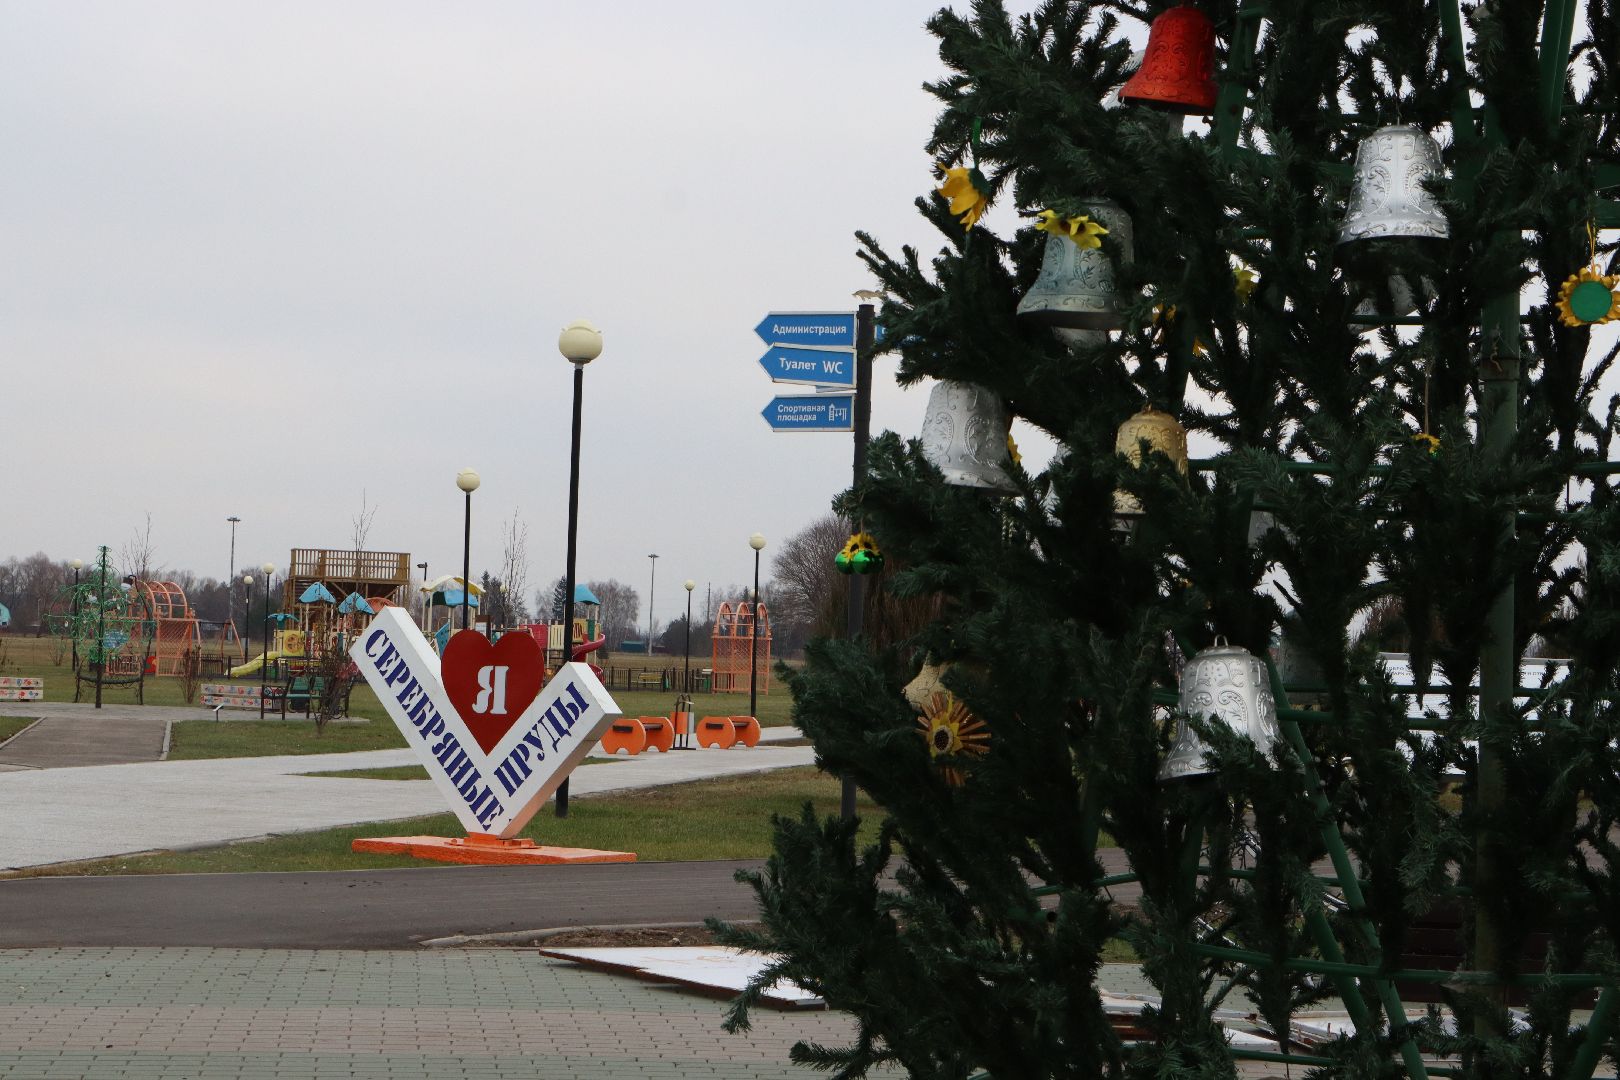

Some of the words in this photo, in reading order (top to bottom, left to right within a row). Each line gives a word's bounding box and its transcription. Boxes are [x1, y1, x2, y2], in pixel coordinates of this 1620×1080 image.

[772, 324, 847, 336] Администрация
[779, 357, 816, 371] Туалет
[823, 360, 843, 374] WC
[777, 404, 826, 413] Спортивная
[777, 414, 817, 422] площадка
[472, 665, 509, 715] Я
[365, 629, 505, 832] СЕРЕБРЯНЫЕ
[493, 682, 590, 797] ПРУДЫ
